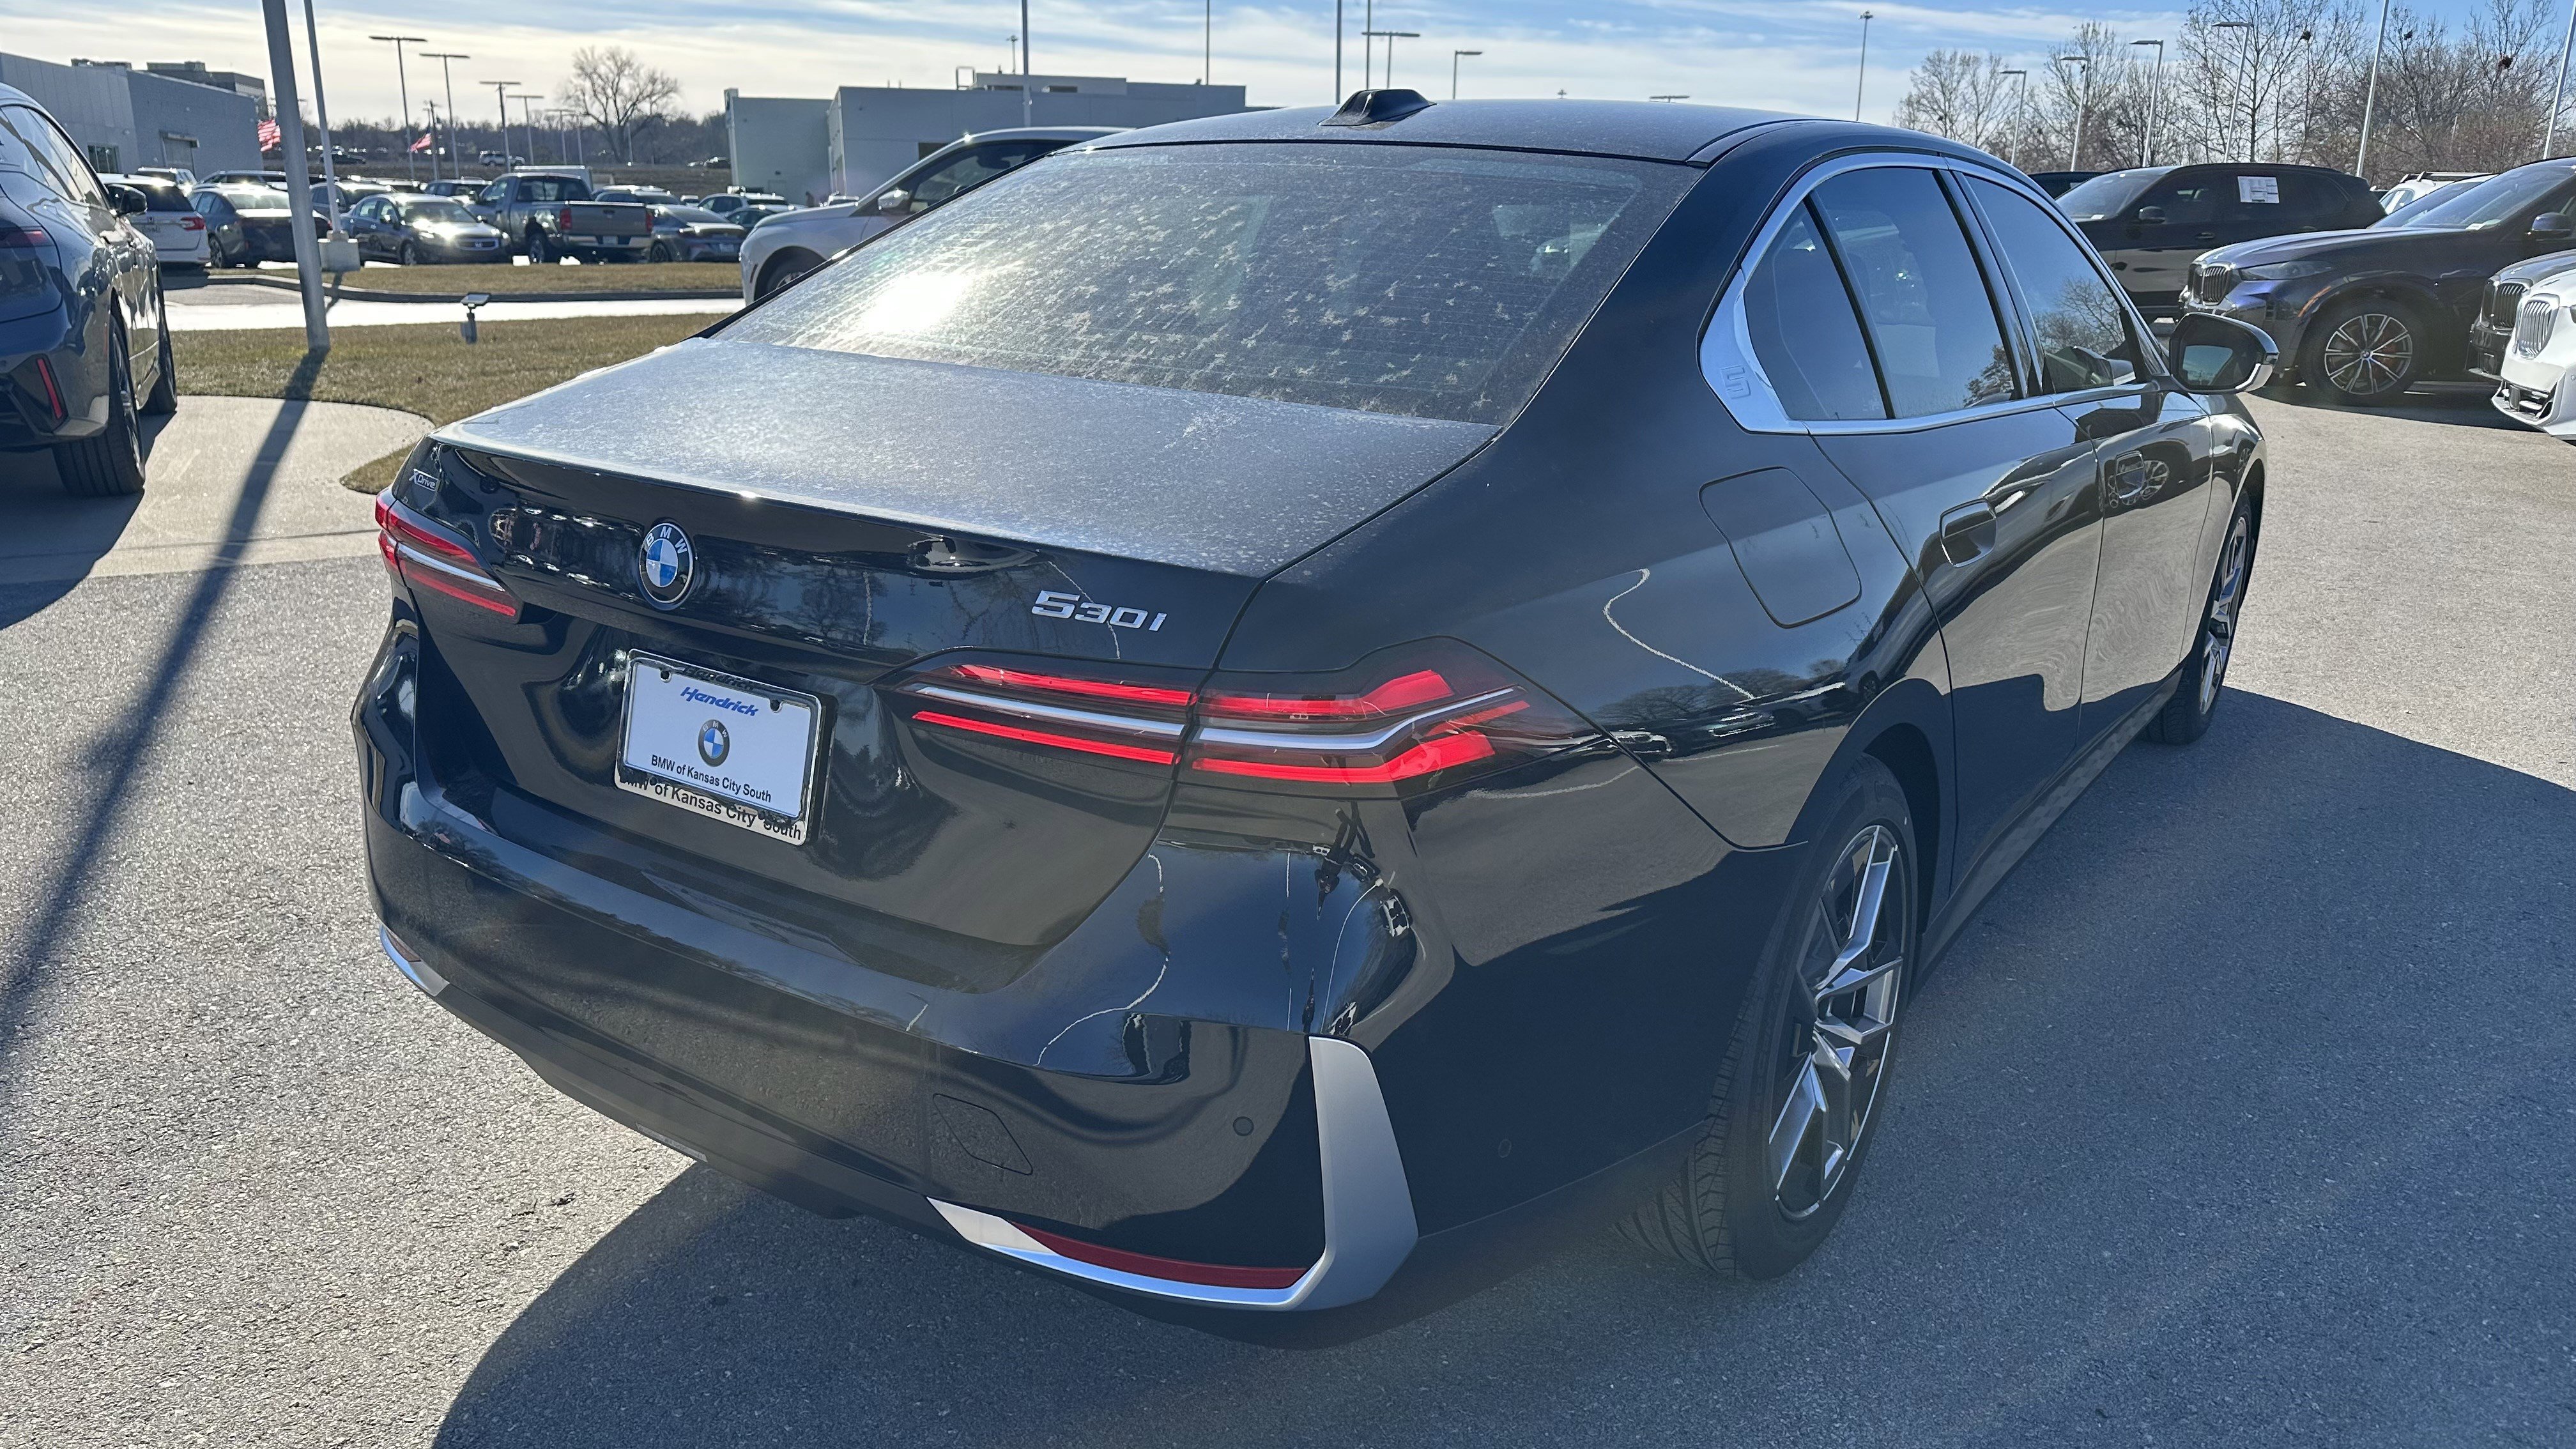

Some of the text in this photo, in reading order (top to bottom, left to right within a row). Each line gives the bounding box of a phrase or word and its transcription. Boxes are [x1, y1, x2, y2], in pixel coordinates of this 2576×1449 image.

[1720, 365, 1751, 400] 5
[646, 526, 688, 554] BMW
[680, 686, 759, 716] Hendrick
[703, 720, 728, 738] BMW
[652, 754, 771, 803] BMW of Kansas City South
[655, 783, 669, 797] of
[671, 786, 722, 815] Kansas
[726, 804, 757, 828] City
